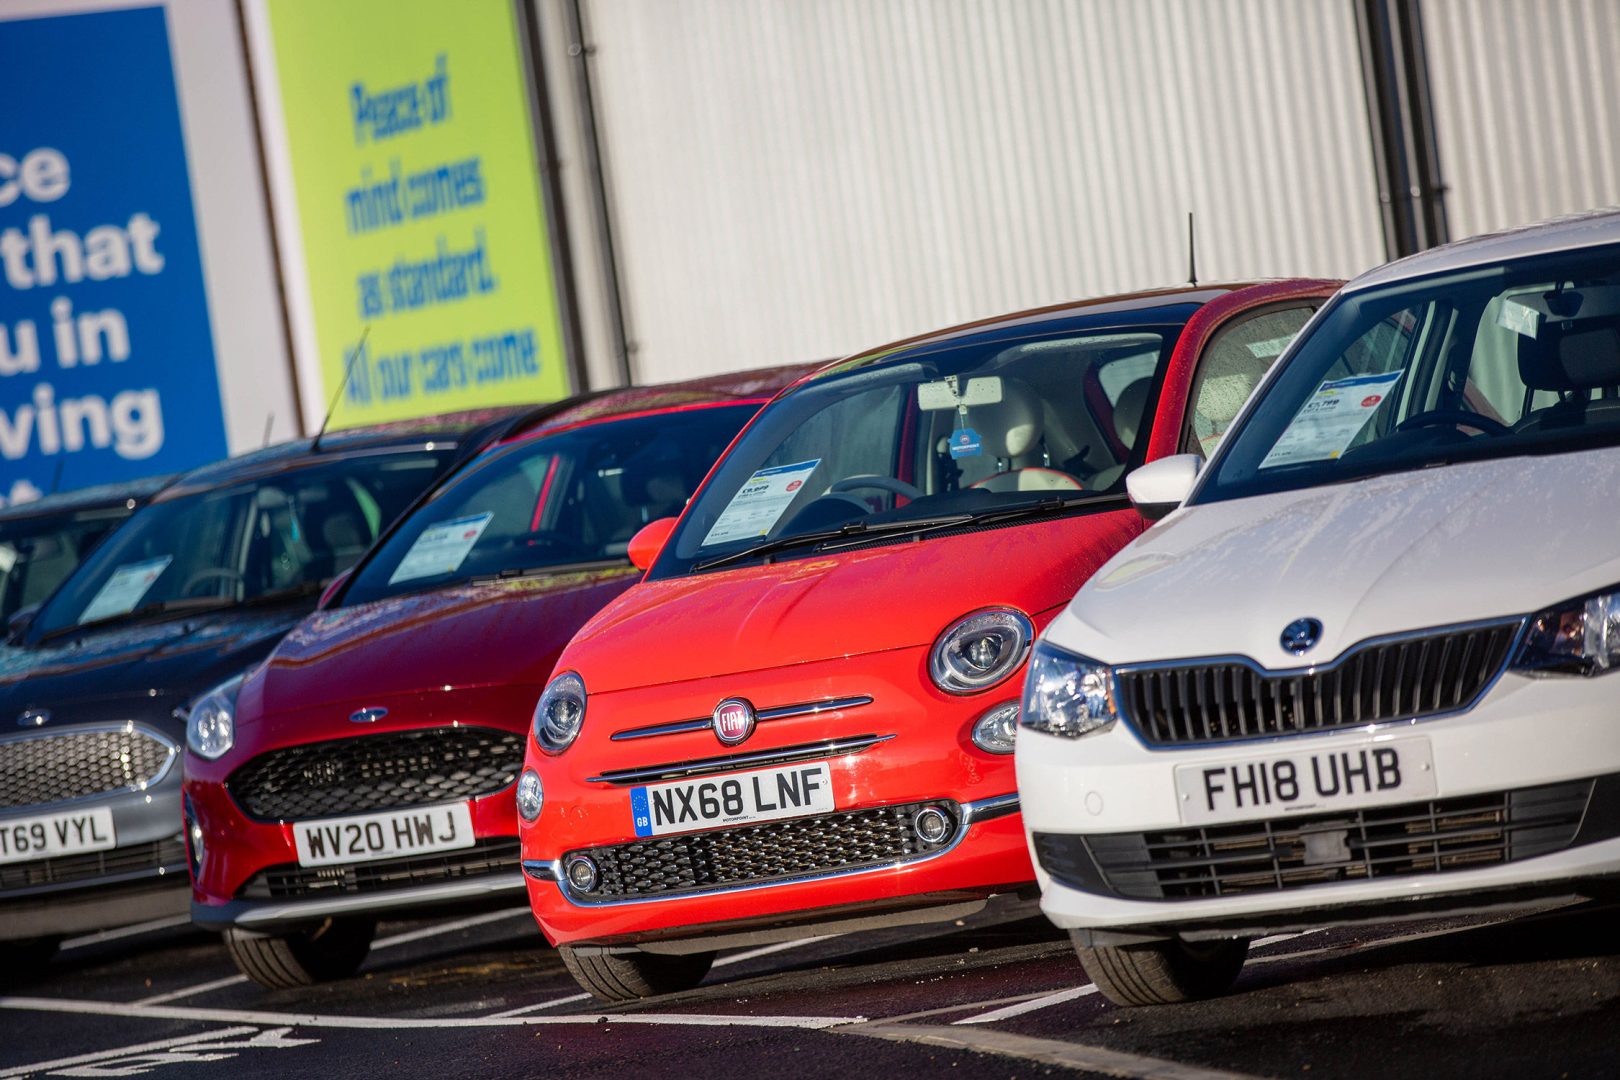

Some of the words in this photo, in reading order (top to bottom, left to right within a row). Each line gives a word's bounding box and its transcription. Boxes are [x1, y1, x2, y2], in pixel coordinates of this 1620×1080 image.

[349, 80, 424, 146] Peace
[422, 52, 453, 127] of
[346, 156, 404, 236] mind
[404, 154, 486, 219] comes
[0, 212, 165, 289] that
[359, 270, 386, 321] as
[51, 296, 131, 368] in
[377, 350, 413, 402] our
[417, 341, 469, 395] cars
[470, 327, 541, 386] come
[721, 710, 744, 732] FIAT
[652, 779, 744, 826] NX68
[752, 767, 822, 813] LNF
[1202, 759, 1300, 811] FH18
[1310, 747, 1402, 798] UHB
[54, 815, 108, 847] VYL
[306, 821, 385, 860] WV20
[392, 811, 457, 849] HWJ
[636, 816, 649, 828] GB
